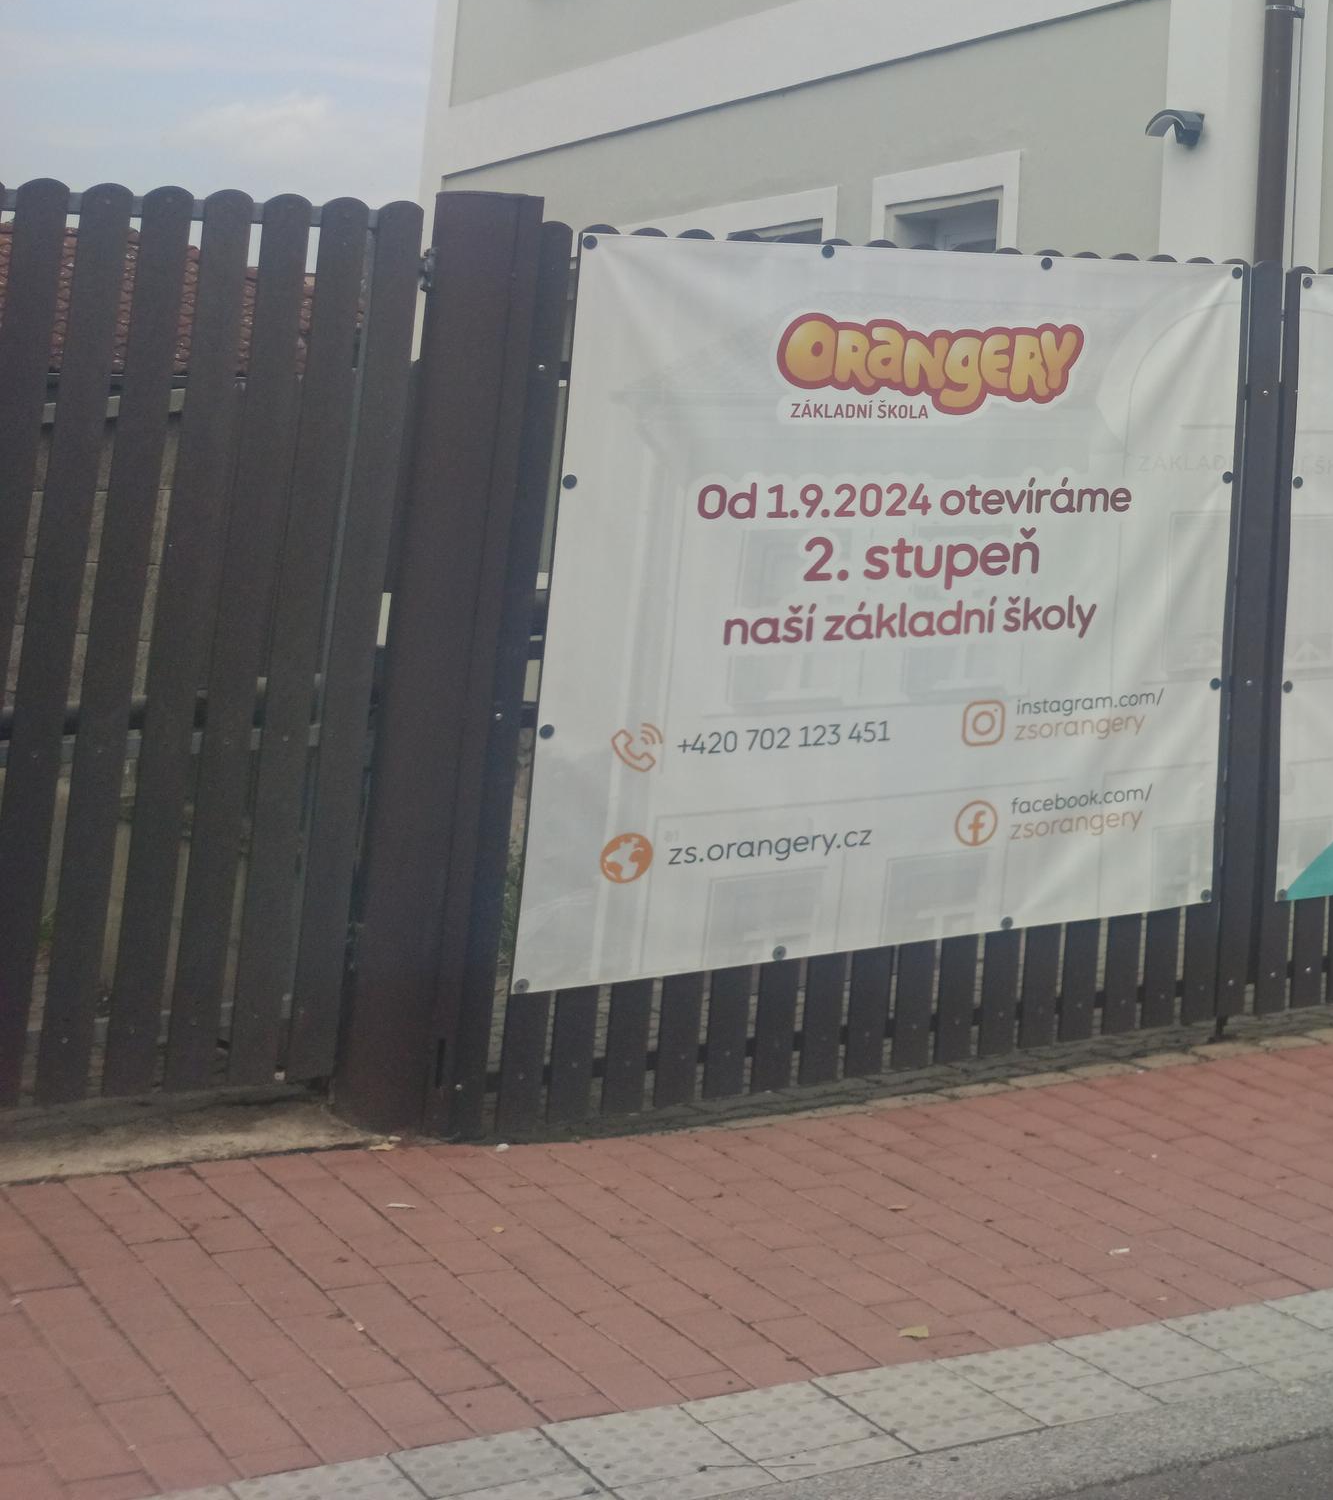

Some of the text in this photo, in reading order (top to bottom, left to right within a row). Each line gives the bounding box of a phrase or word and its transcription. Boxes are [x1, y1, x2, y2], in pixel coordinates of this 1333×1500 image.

[790, 399, 929, 419] ZÁKLADNÍ ŠKOLA
[697, 477, 1132, 520] Od 1.9.2024 otevíráme
[803, 527, 1040, 590] 2. stupeň
[723, 594, 1097, 646] naší základní školy
[1015, 687, 1165, 717] instagram.com/
[677, 720, 891, 755] +420 702 123 451
[1014, 715, 1146, 741] zsorangery
[1011, 783, 1153, 815] facebook.com/
[1009, 810, 1143, 841] zsorangery
[668, 828, 872, 865] zs.orangery.cz
